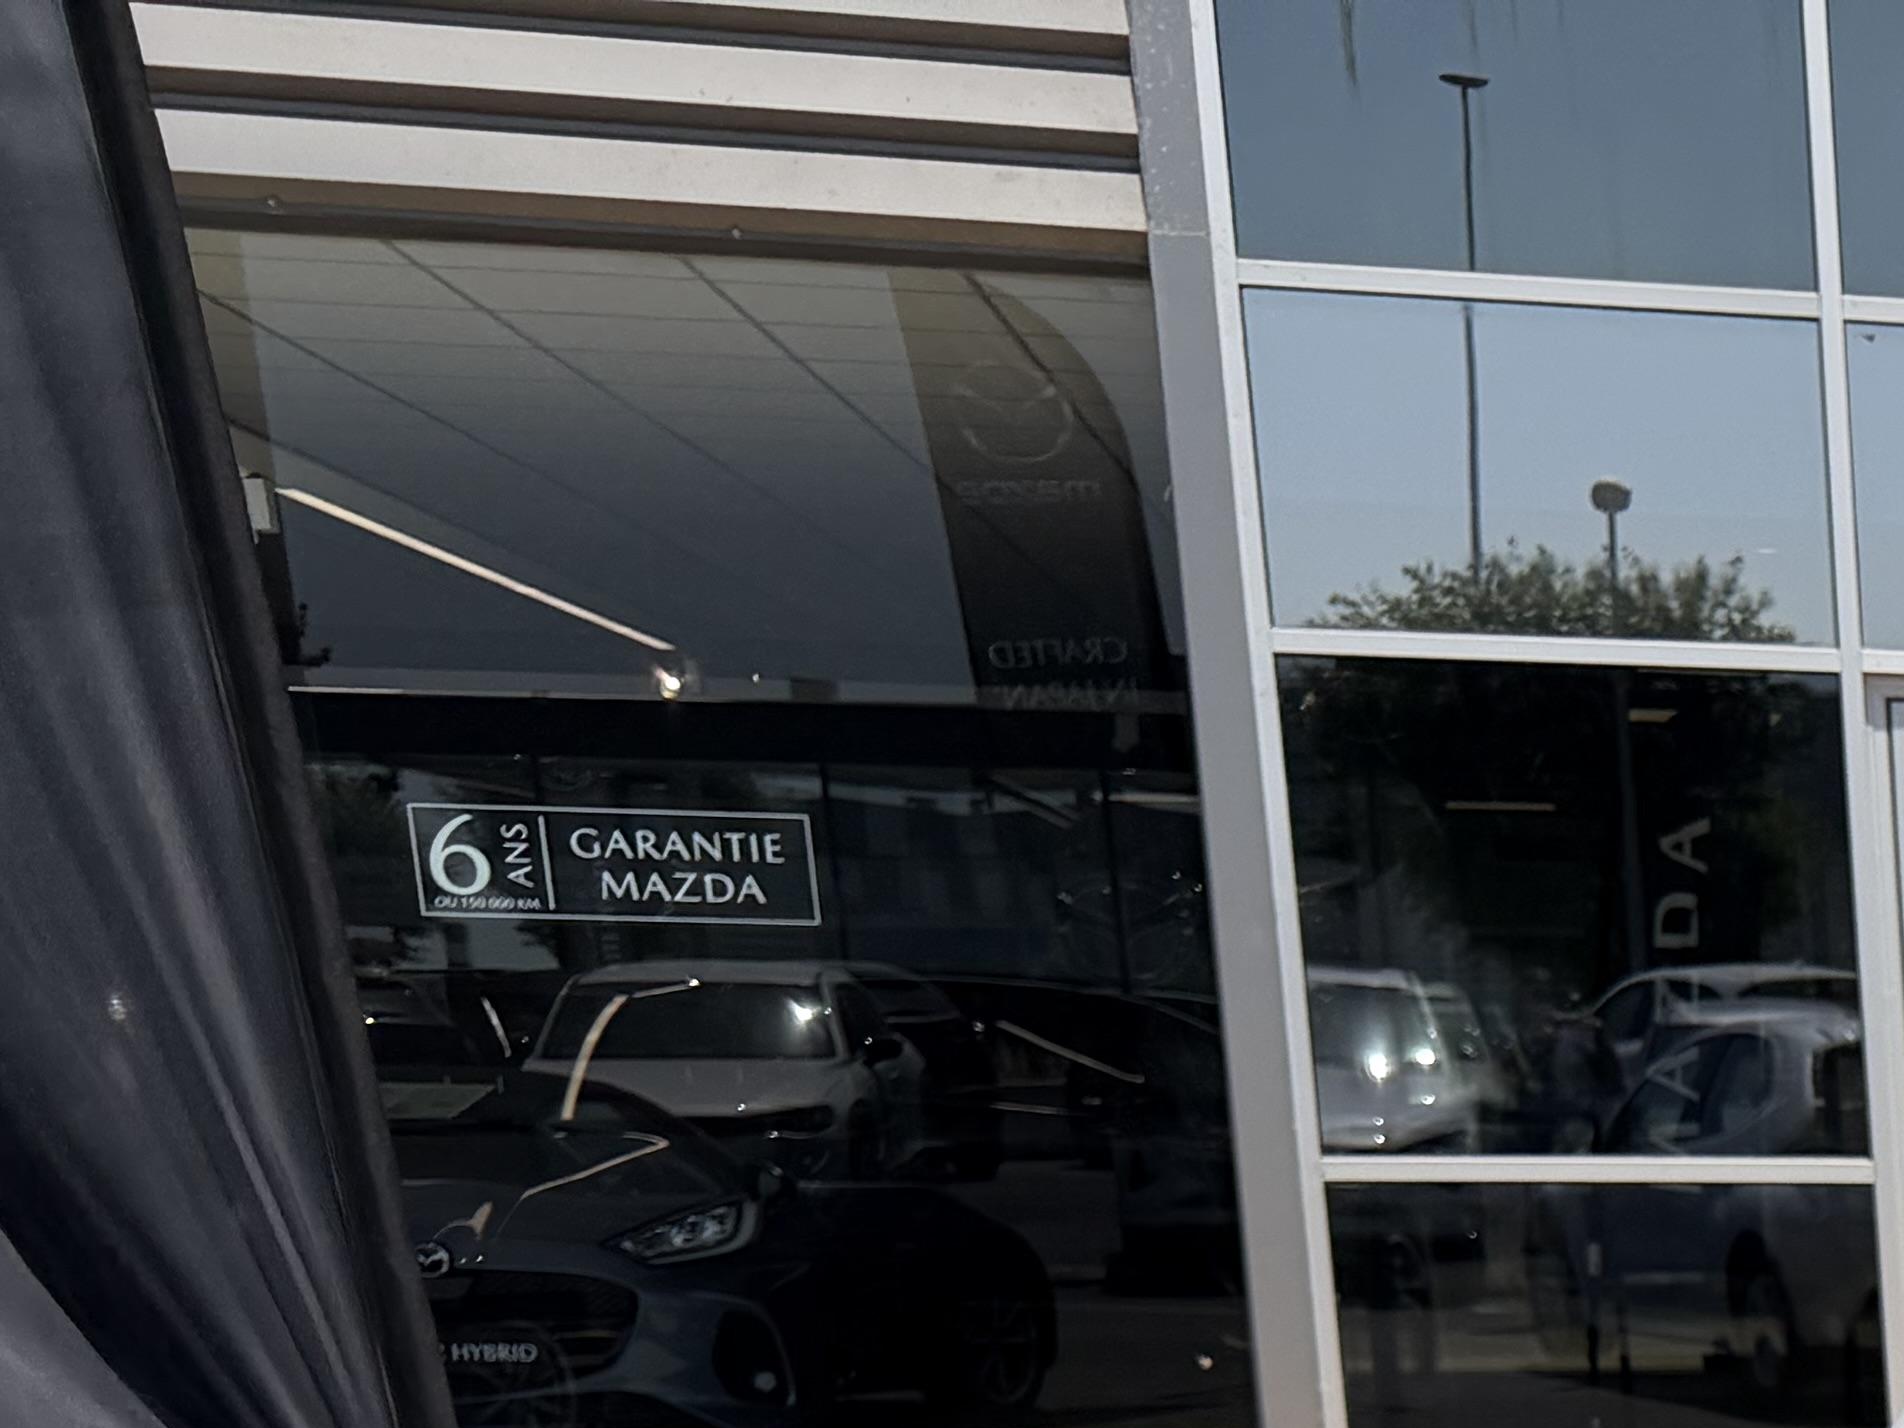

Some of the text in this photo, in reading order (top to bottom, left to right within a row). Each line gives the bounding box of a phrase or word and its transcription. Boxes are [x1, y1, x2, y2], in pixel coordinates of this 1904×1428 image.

[429, 813, 535, 895] 6 ANS
[569, 827, 785, 864] GARANTIE
[601, 871, 767, 904] MAZDA
[450, 1342, 538, 1363] HYBRID
